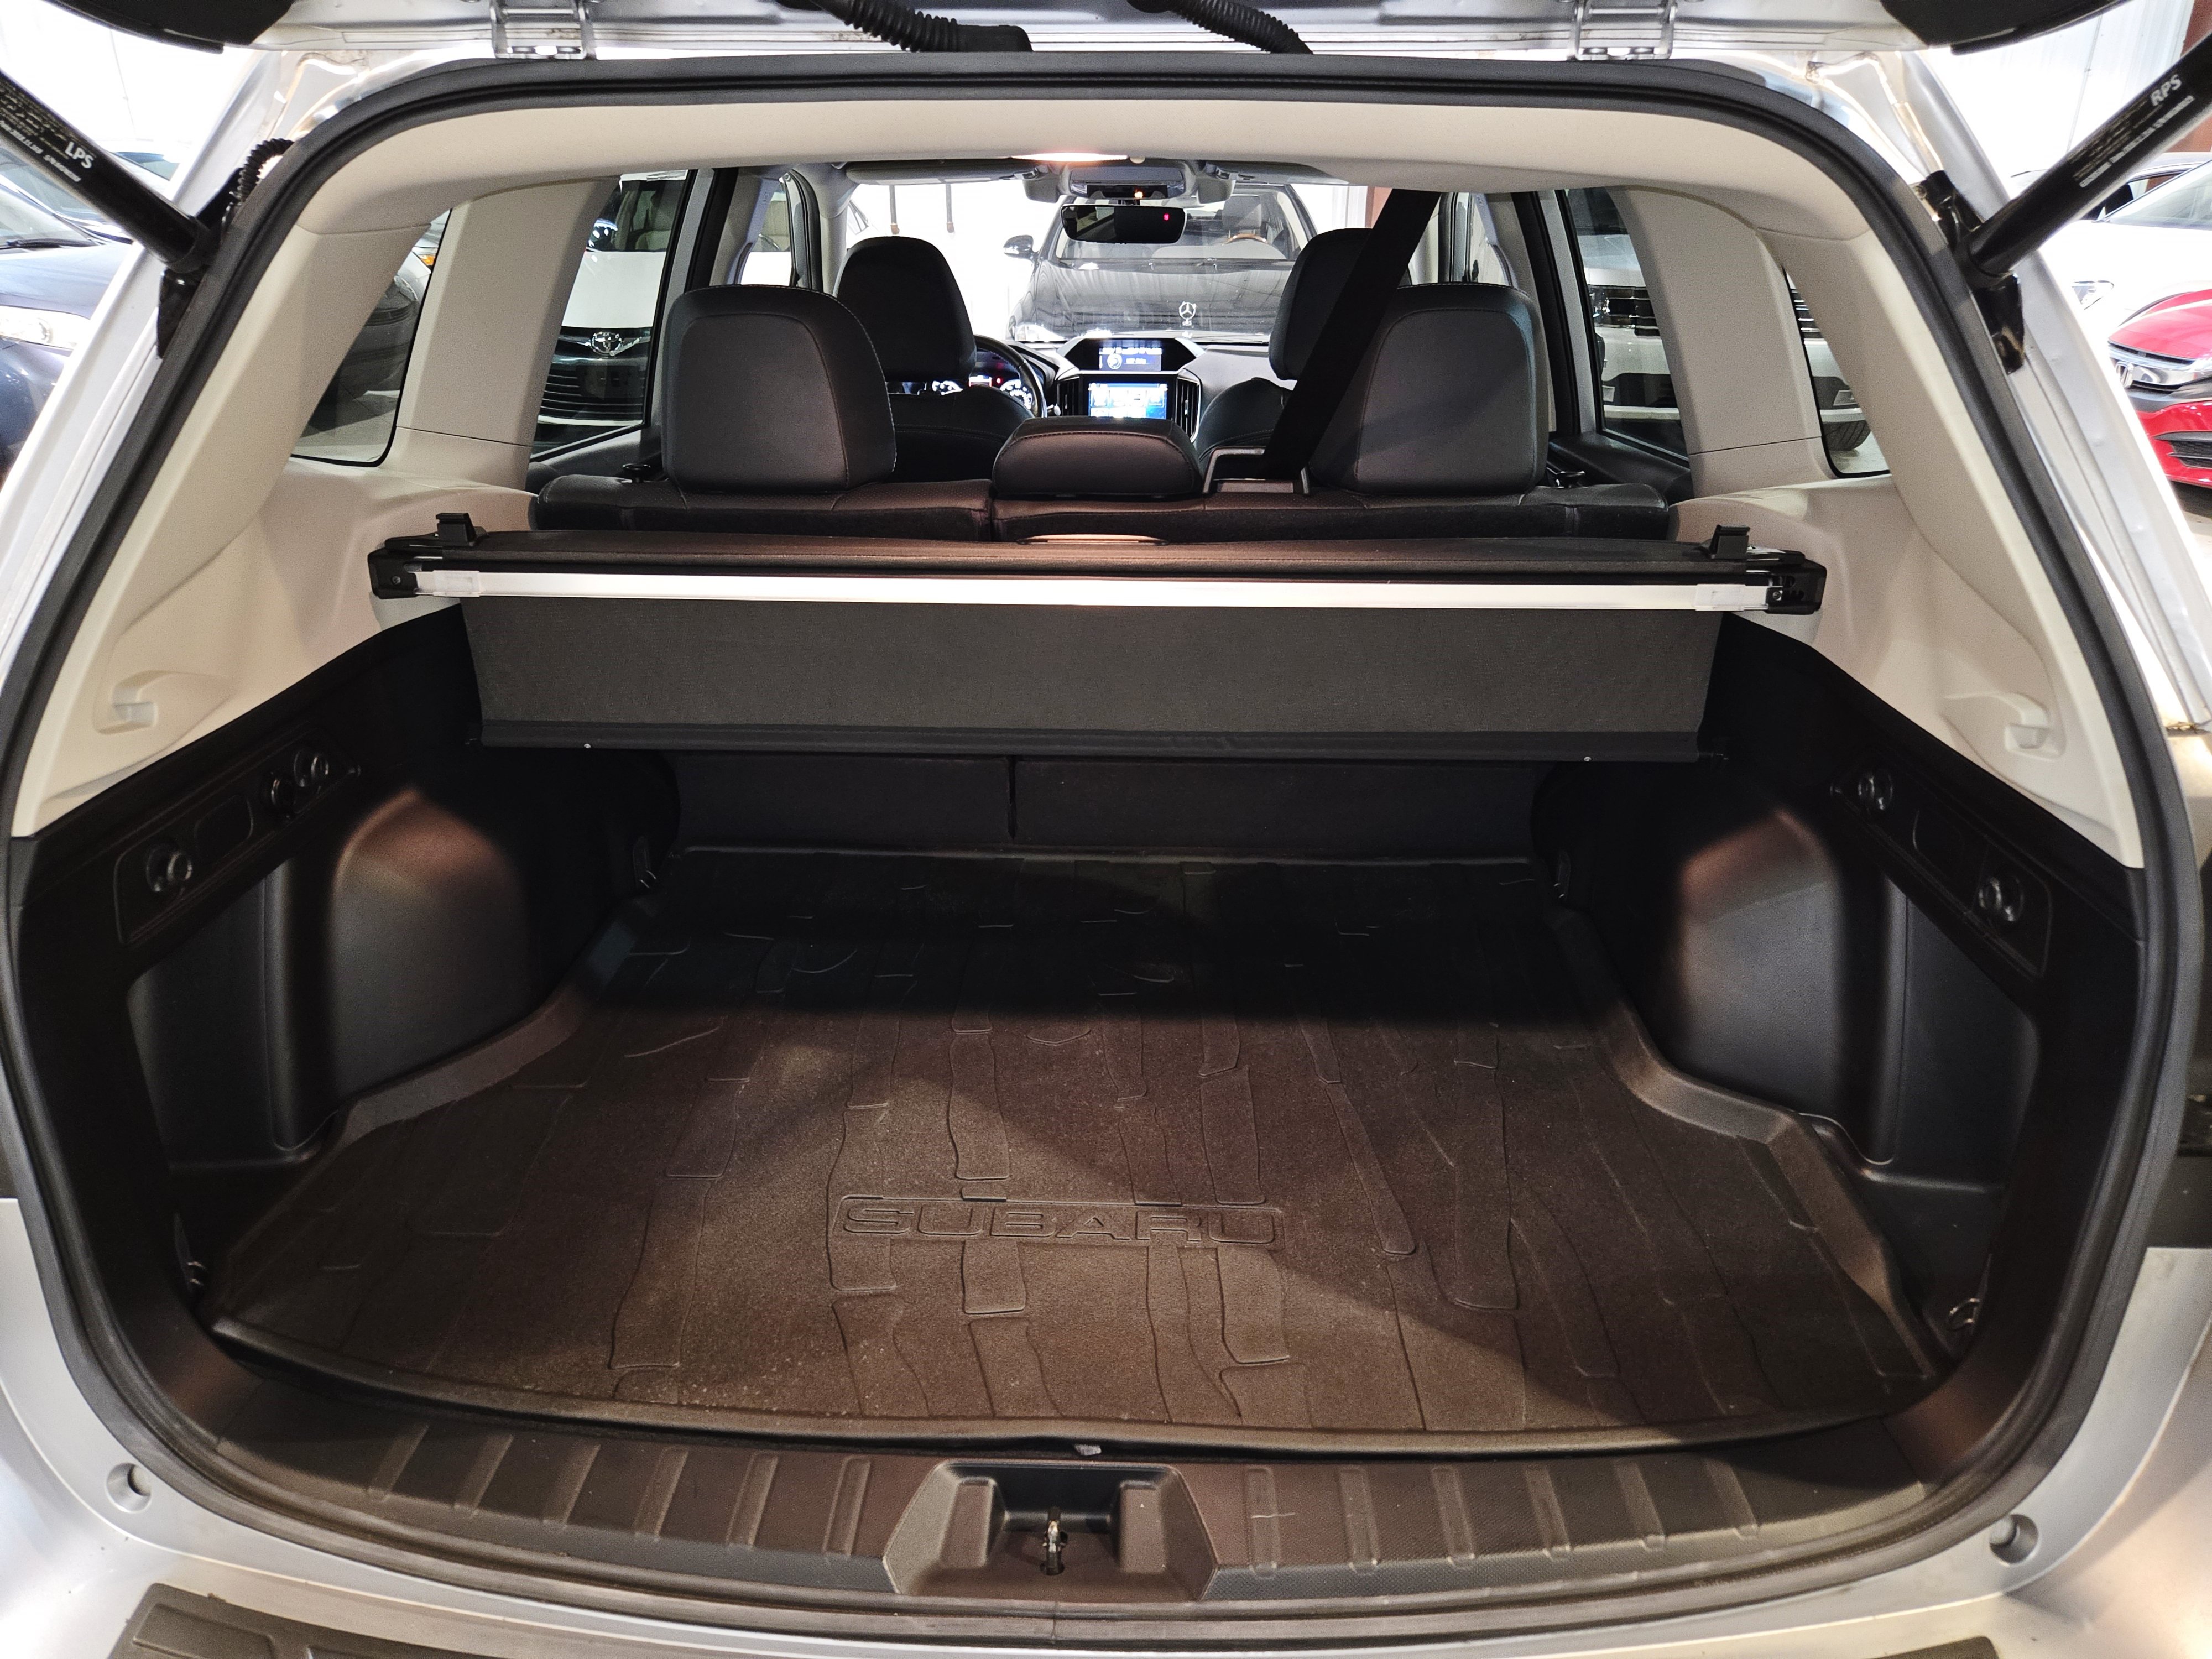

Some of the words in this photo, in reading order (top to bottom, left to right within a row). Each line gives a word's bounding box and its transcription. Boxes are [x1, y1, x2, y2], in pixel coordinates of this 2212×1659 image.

[2150, 74, 2182, 106] RPS
[65, 142, 93, 168] LPS
[843, 1204, 1276, 1245] SUBARU
